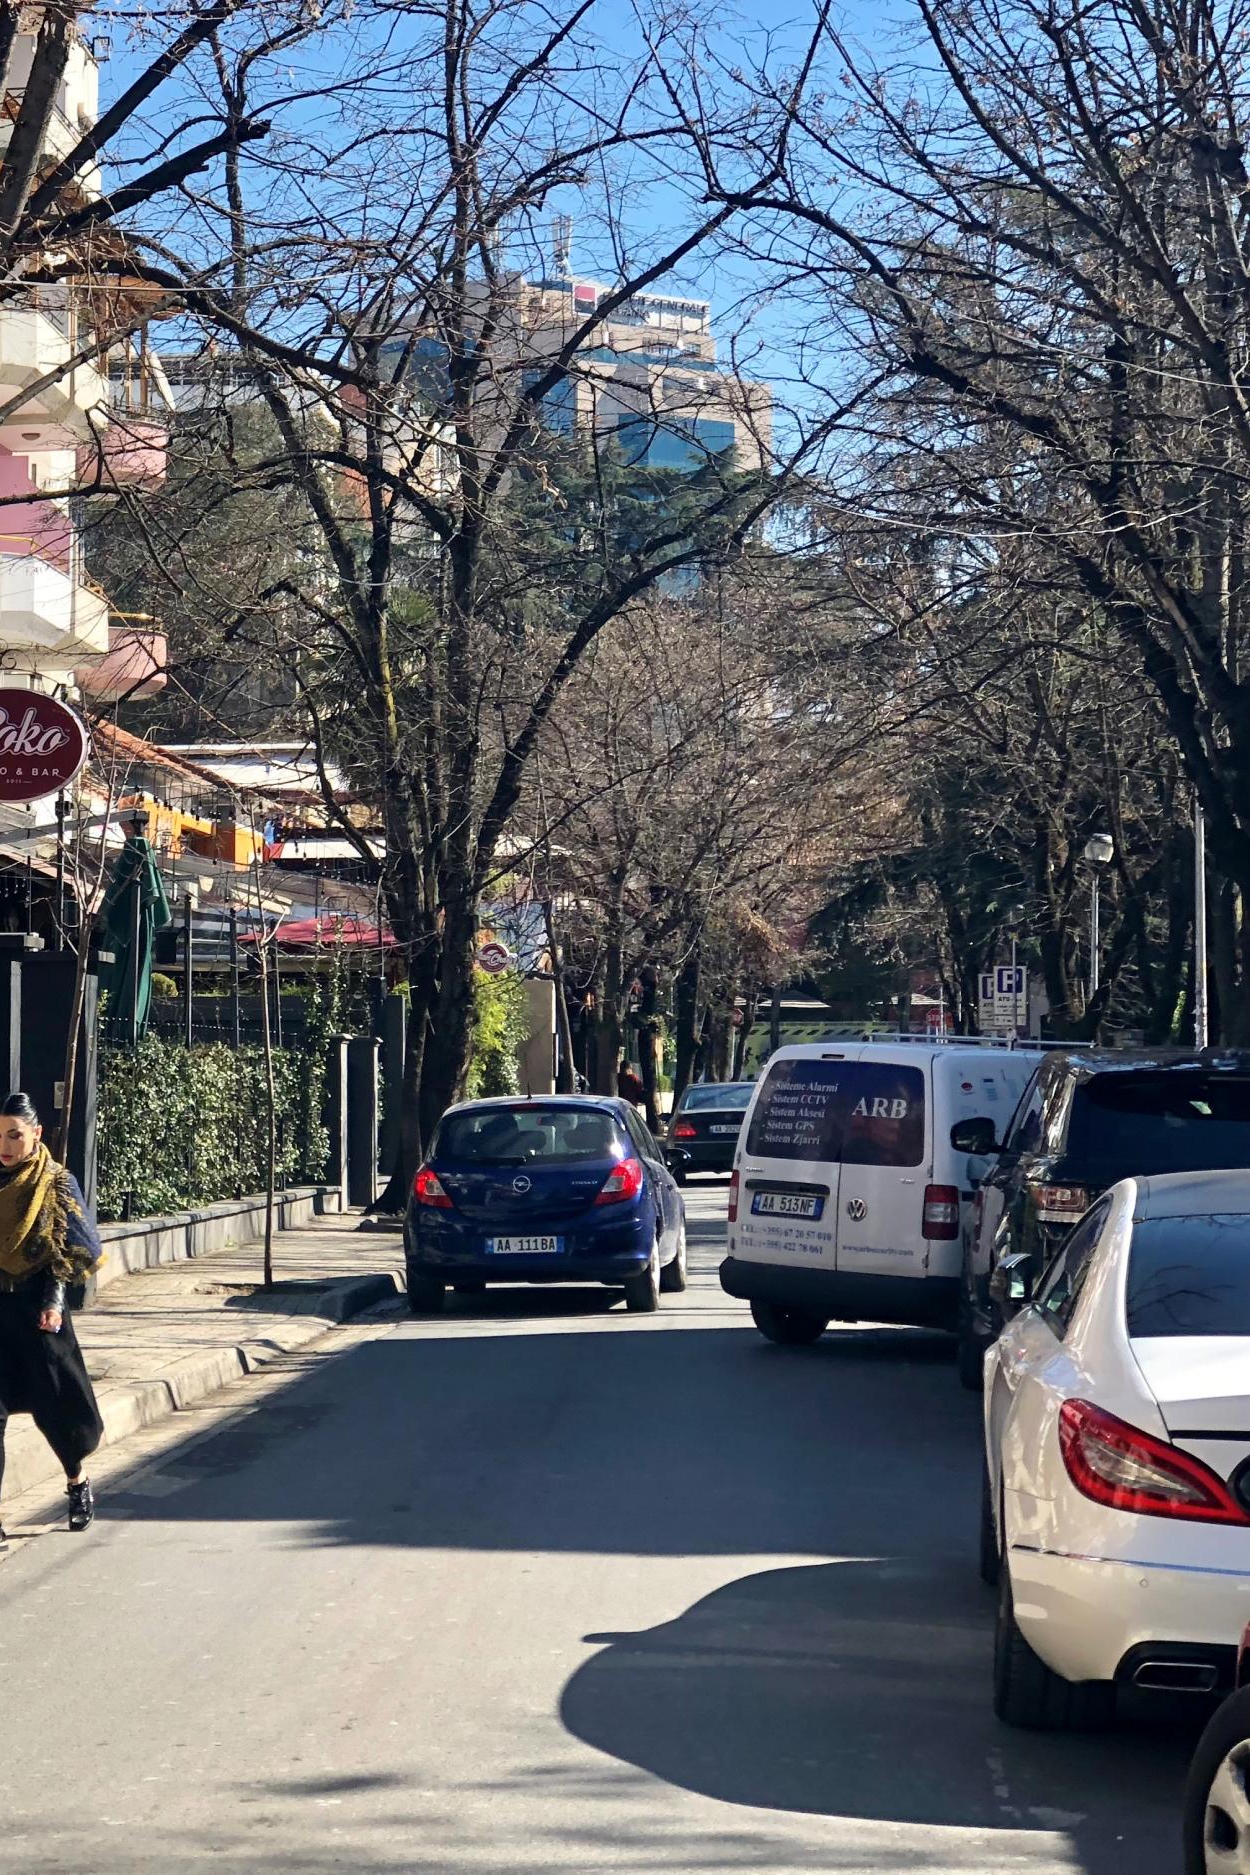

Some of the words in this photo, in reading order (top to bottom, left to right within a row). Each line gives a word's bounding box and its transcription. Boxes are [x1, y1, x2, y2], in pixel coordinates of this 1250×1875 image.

[15, 767, 23, 775] &
[31, 768, 59, 776] BAR
[775, 1080, 806, 1091] Sisteme
[807, 1082, 838, 1092] Alarmi
[772, 1094, 798, 1103] Sistem
[800, 1094, 829, 1105] CCTV
[769, 1107, 796, 1117] Sistem
[797, 1107, 826, 1118] Aksesi
[852, 1097, 907, 1118] ARB
[767, 1120, 793, 1130] Sistem
[795, 1121, 815, 1131] GPS
[764, 1134, 790, 1143] Sistem
[792, 1133, 820, 1146] Zjarri
[762, 1196, 775, 1210] AA
[497, 1239, 511, 1251] AA
